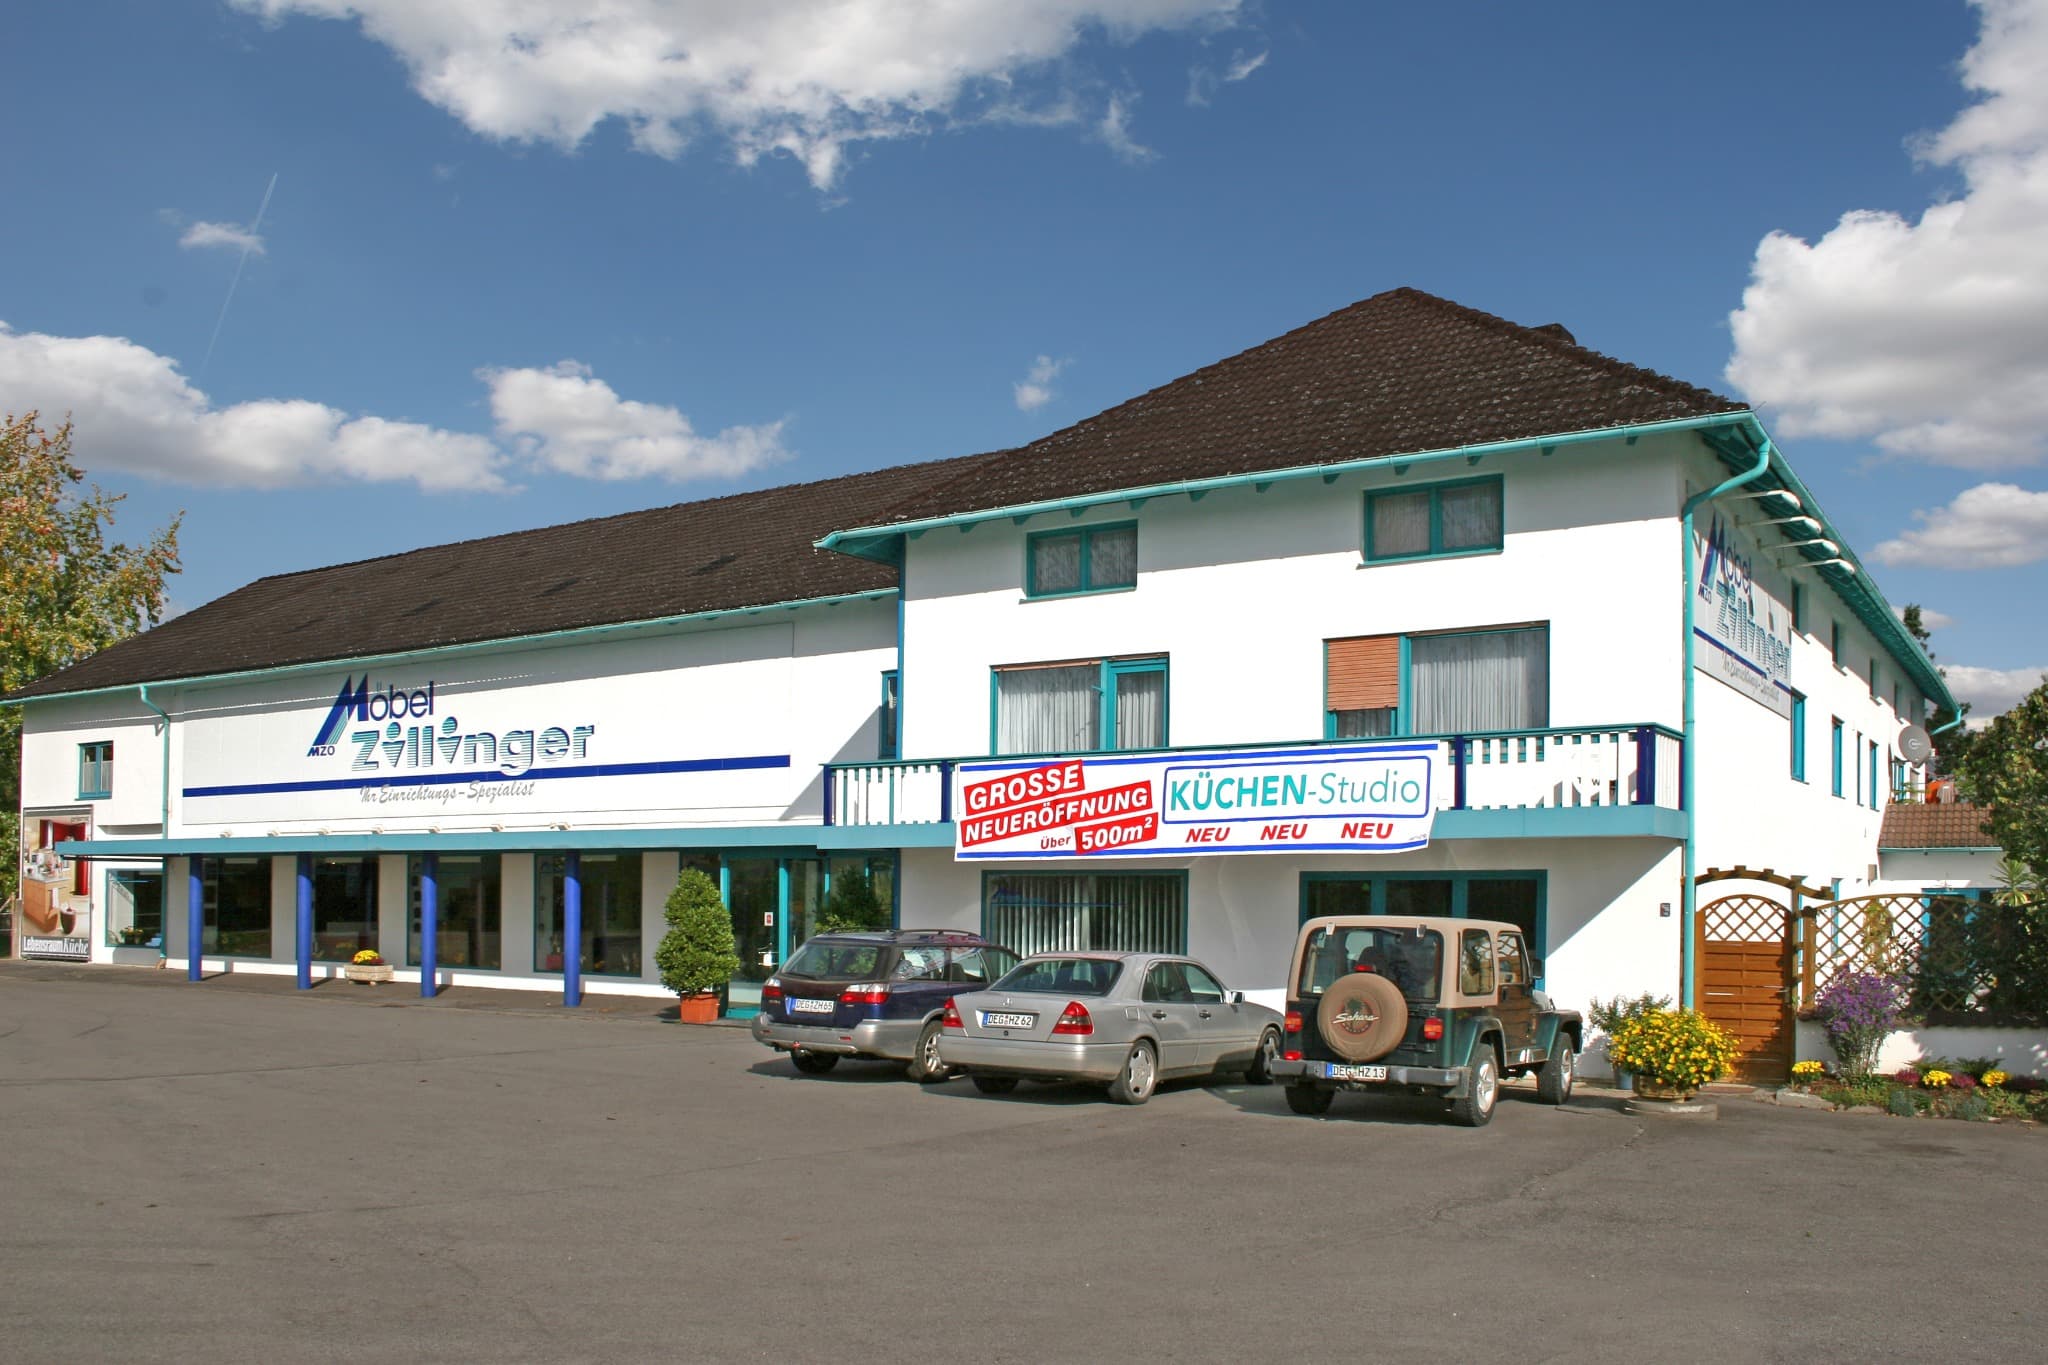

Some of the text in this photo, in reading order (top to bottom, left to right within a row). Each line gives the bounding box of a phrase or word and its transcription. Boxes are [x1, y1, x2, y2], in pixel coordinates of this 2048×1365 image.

[312, 672, 434, 746] Möbel
[306, 745, 336, 757] MZO
[352, 716, 594, 776] Zillinger
[360, 784, 377, 804] Ihr
[969, 764, 1080, 810] GROSSE
[1170, 768, 1420, 812] KÜCHEN-Studio
[965, 787, 1148, 842] NEUERÖFFNUNG
[1040, 835, 1071, 850] Über
[1185, 823, 1394, 843] NEU NEU NEU
[988, 1014, 1004, 1025] DEG
